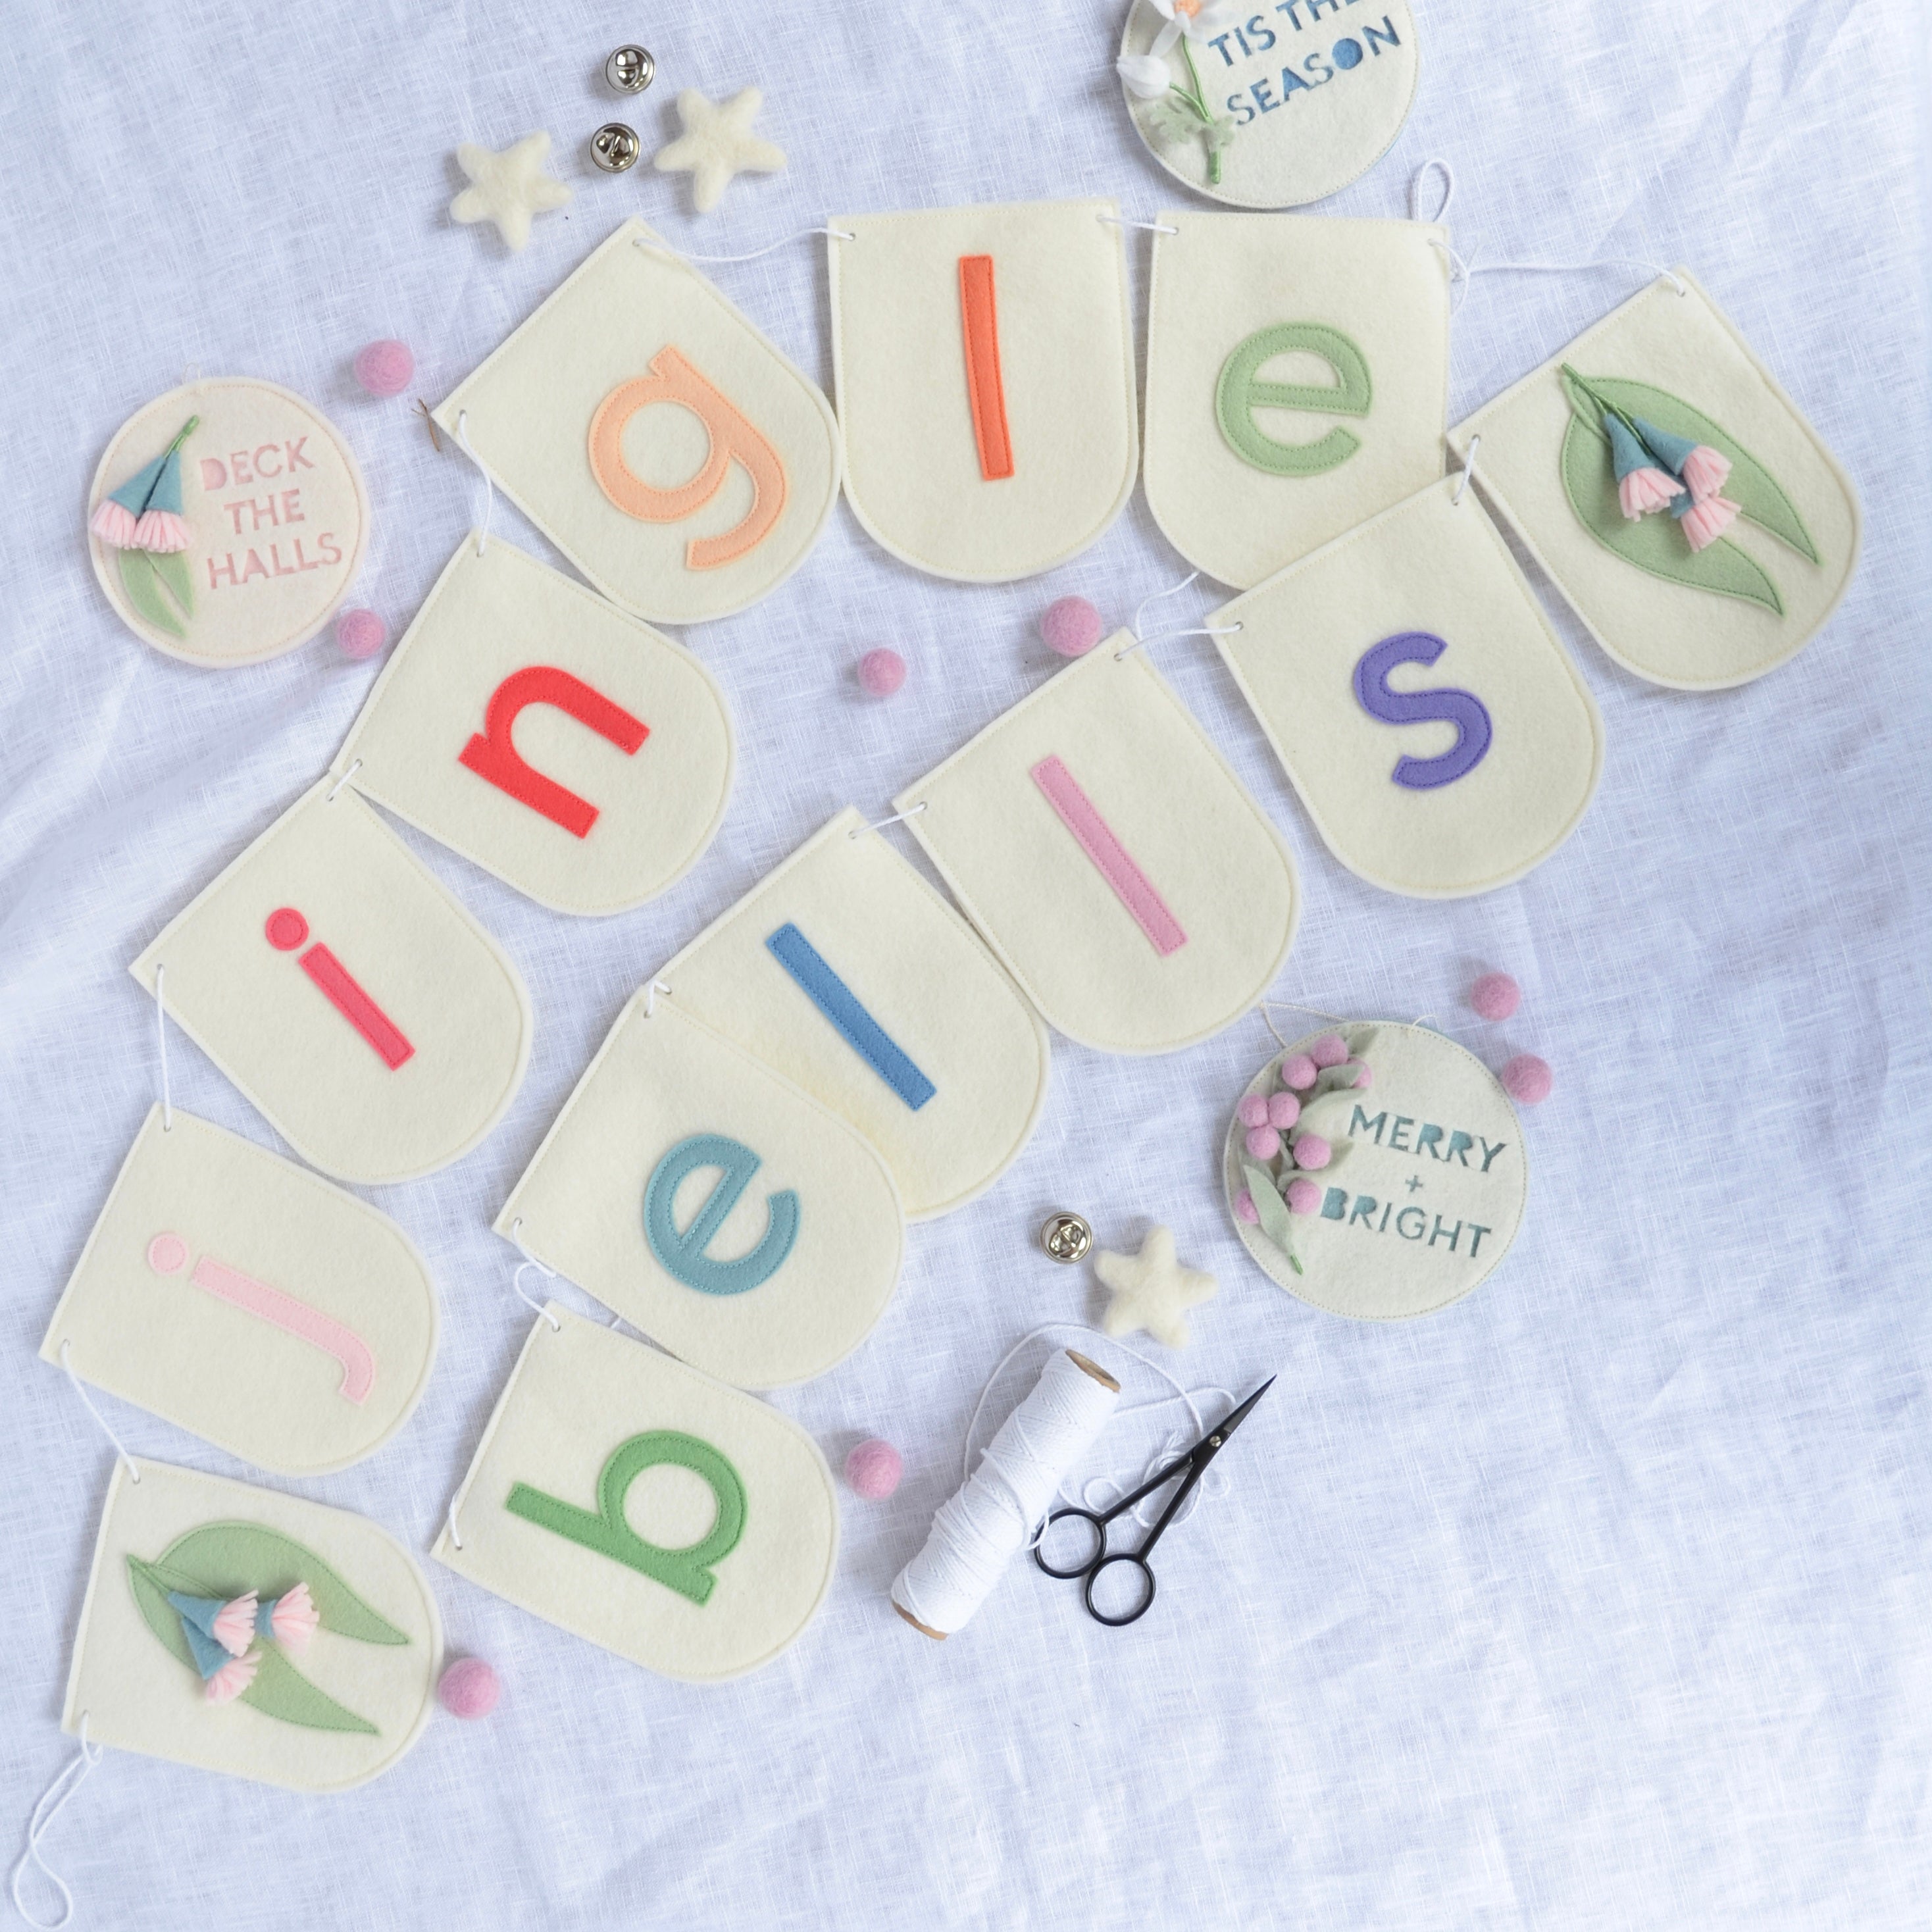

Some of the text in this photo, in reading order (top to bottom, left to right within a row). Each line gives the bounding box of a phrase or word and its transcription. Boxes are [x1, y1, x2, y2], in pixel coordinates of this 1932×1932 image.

[1208, 0, 1360, 66] TIS TH
[1227, 16, 1402, 126] SEASON
[199, 436, 316, 492] DECK
[224, 488, 305, 535] THE
[207, 532, 343, 590] HALLS
[1348, 1104, 1508, 1173] MERRY
[1320, 1187, 1492, 1258] BRIGHT
